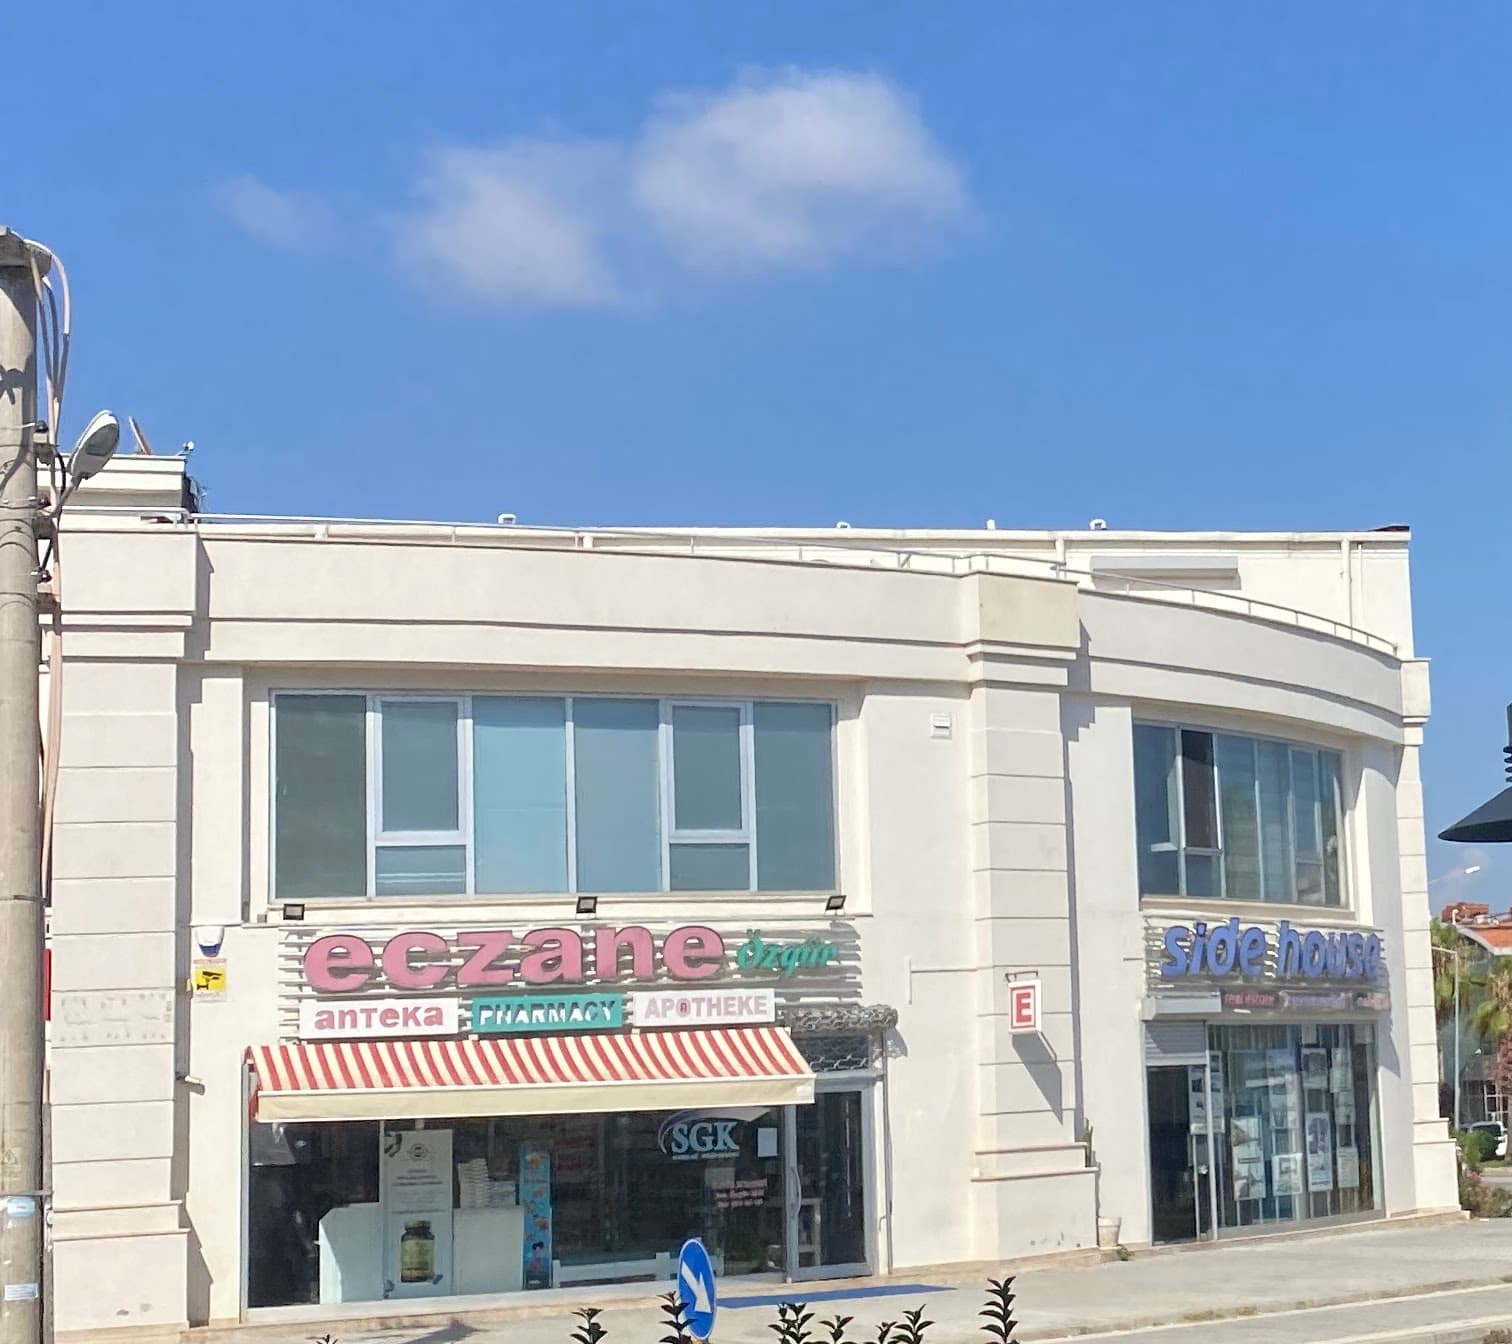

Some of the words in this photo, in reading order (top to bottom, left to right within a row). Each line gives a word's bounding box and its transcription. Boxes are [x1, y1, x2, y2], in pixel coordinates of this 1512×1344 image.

[303, 925, 726, 992] eczane
[1160, 917, 1266, 977] side
[1276, 919, 1382, 981] house
[479, 1000, 616, 1026] PHARMACY
[645, 995, 768, 1019] APOTHEKE
[1016, 991, 1032, 1023] E
[671, 1121, 740, 1154] SGK
